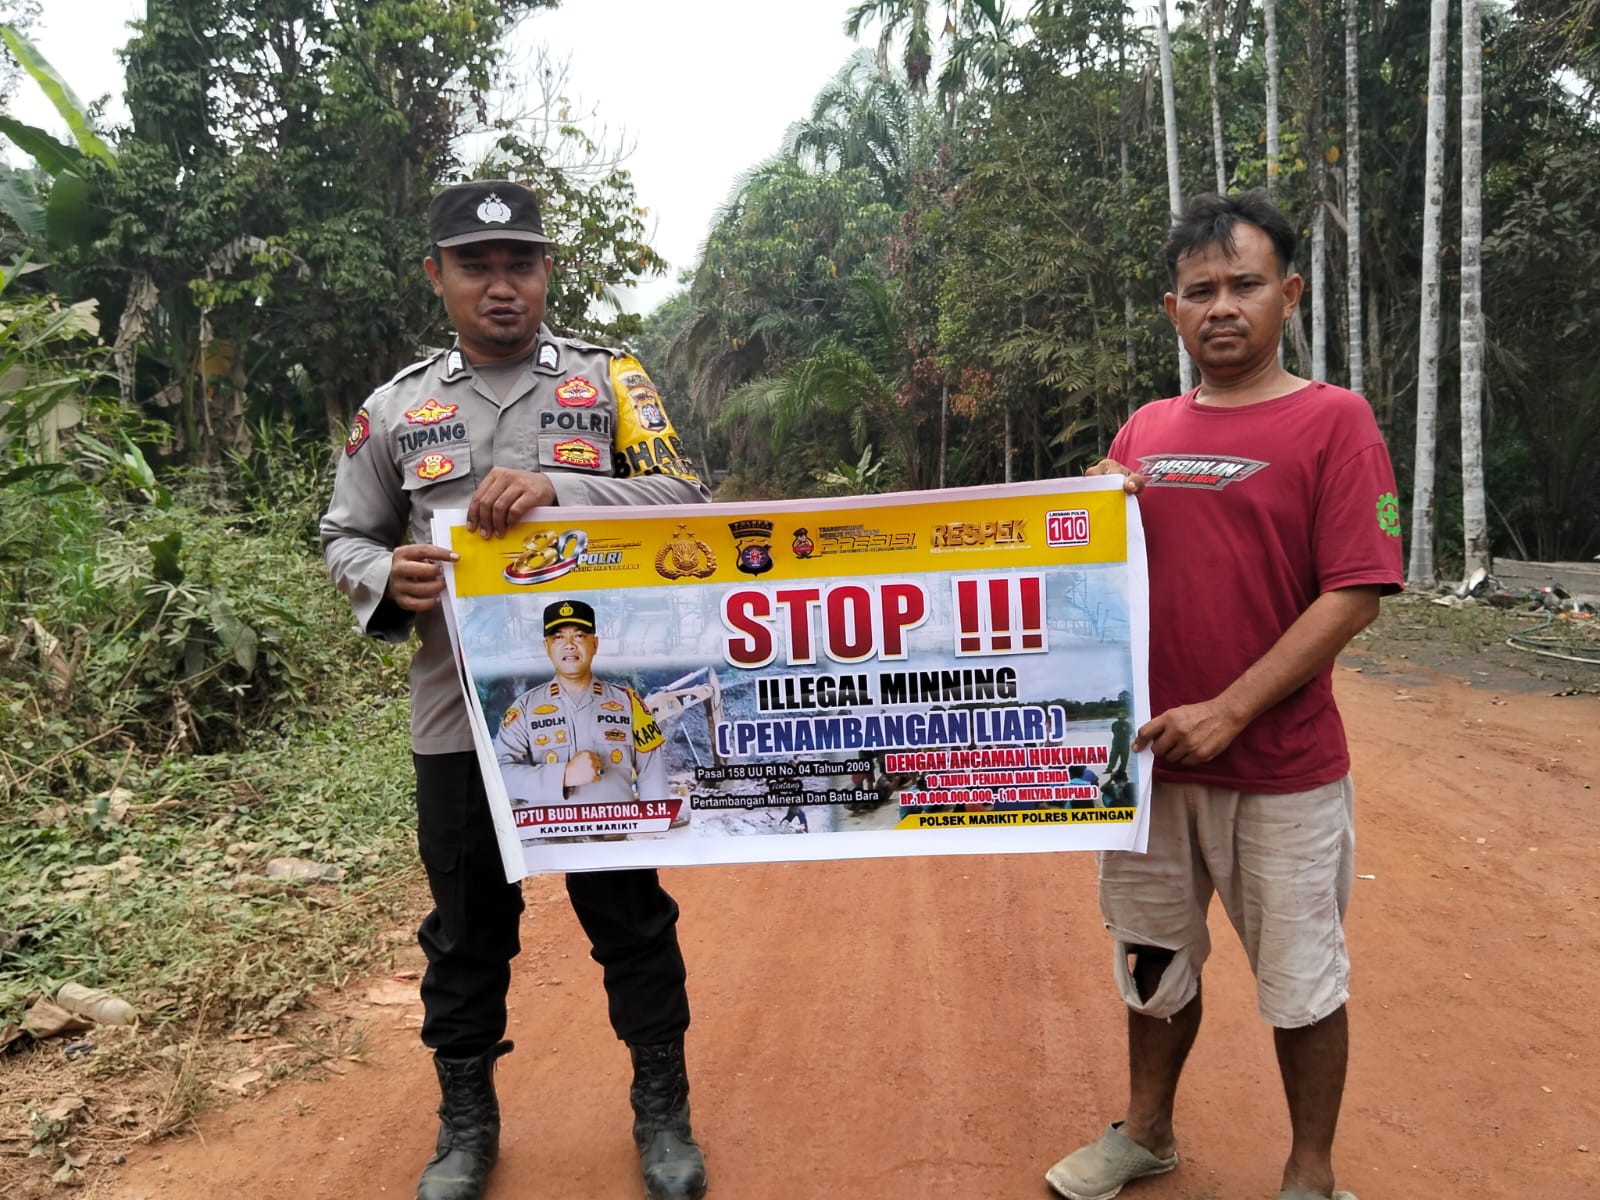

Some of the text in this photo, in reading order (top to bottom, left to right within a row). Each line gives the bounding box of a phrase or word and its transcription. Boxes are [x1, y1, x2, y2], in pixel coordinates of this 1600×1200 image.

[541, 411, 610, 434] POLRI
[399, 422, 466, 453] TUPANG
[1148, 460, 1245, 479] PASUKAN
[930, 519, 1030, 547] RESPEK
[1050, 518, 1087, 539] 110
[577, 551, 623, 566] POLRI
[723, 580, 928, 667] STOP
[757, 666, 1018, 712] ILLEGAL MINNING
[597, 714, 631, 725] POLRI
[886, 746, 1109, 773] DENGAN ANCAMAN HUKUMAN
[697, 761, 871, 780] Pasal 158 UU RI No. 04 Tahun 2009
[926, 775, 938, 788] 10
[939, 773, 971, 787] TAHUN
[692, 790, 880, 809] Pertambangan Mineral Dan Batu Bara
[1018, 787, 1053, 801] MILYAR
[515, 802, 671, 825] IPTU BUDI HARTONO, S.H.
[919, 810, 1134, 827] POLSEK MARIKIT POLRES KATINGAN
[540, 822, 639, 834] KAPOLSEK MARIKIT
